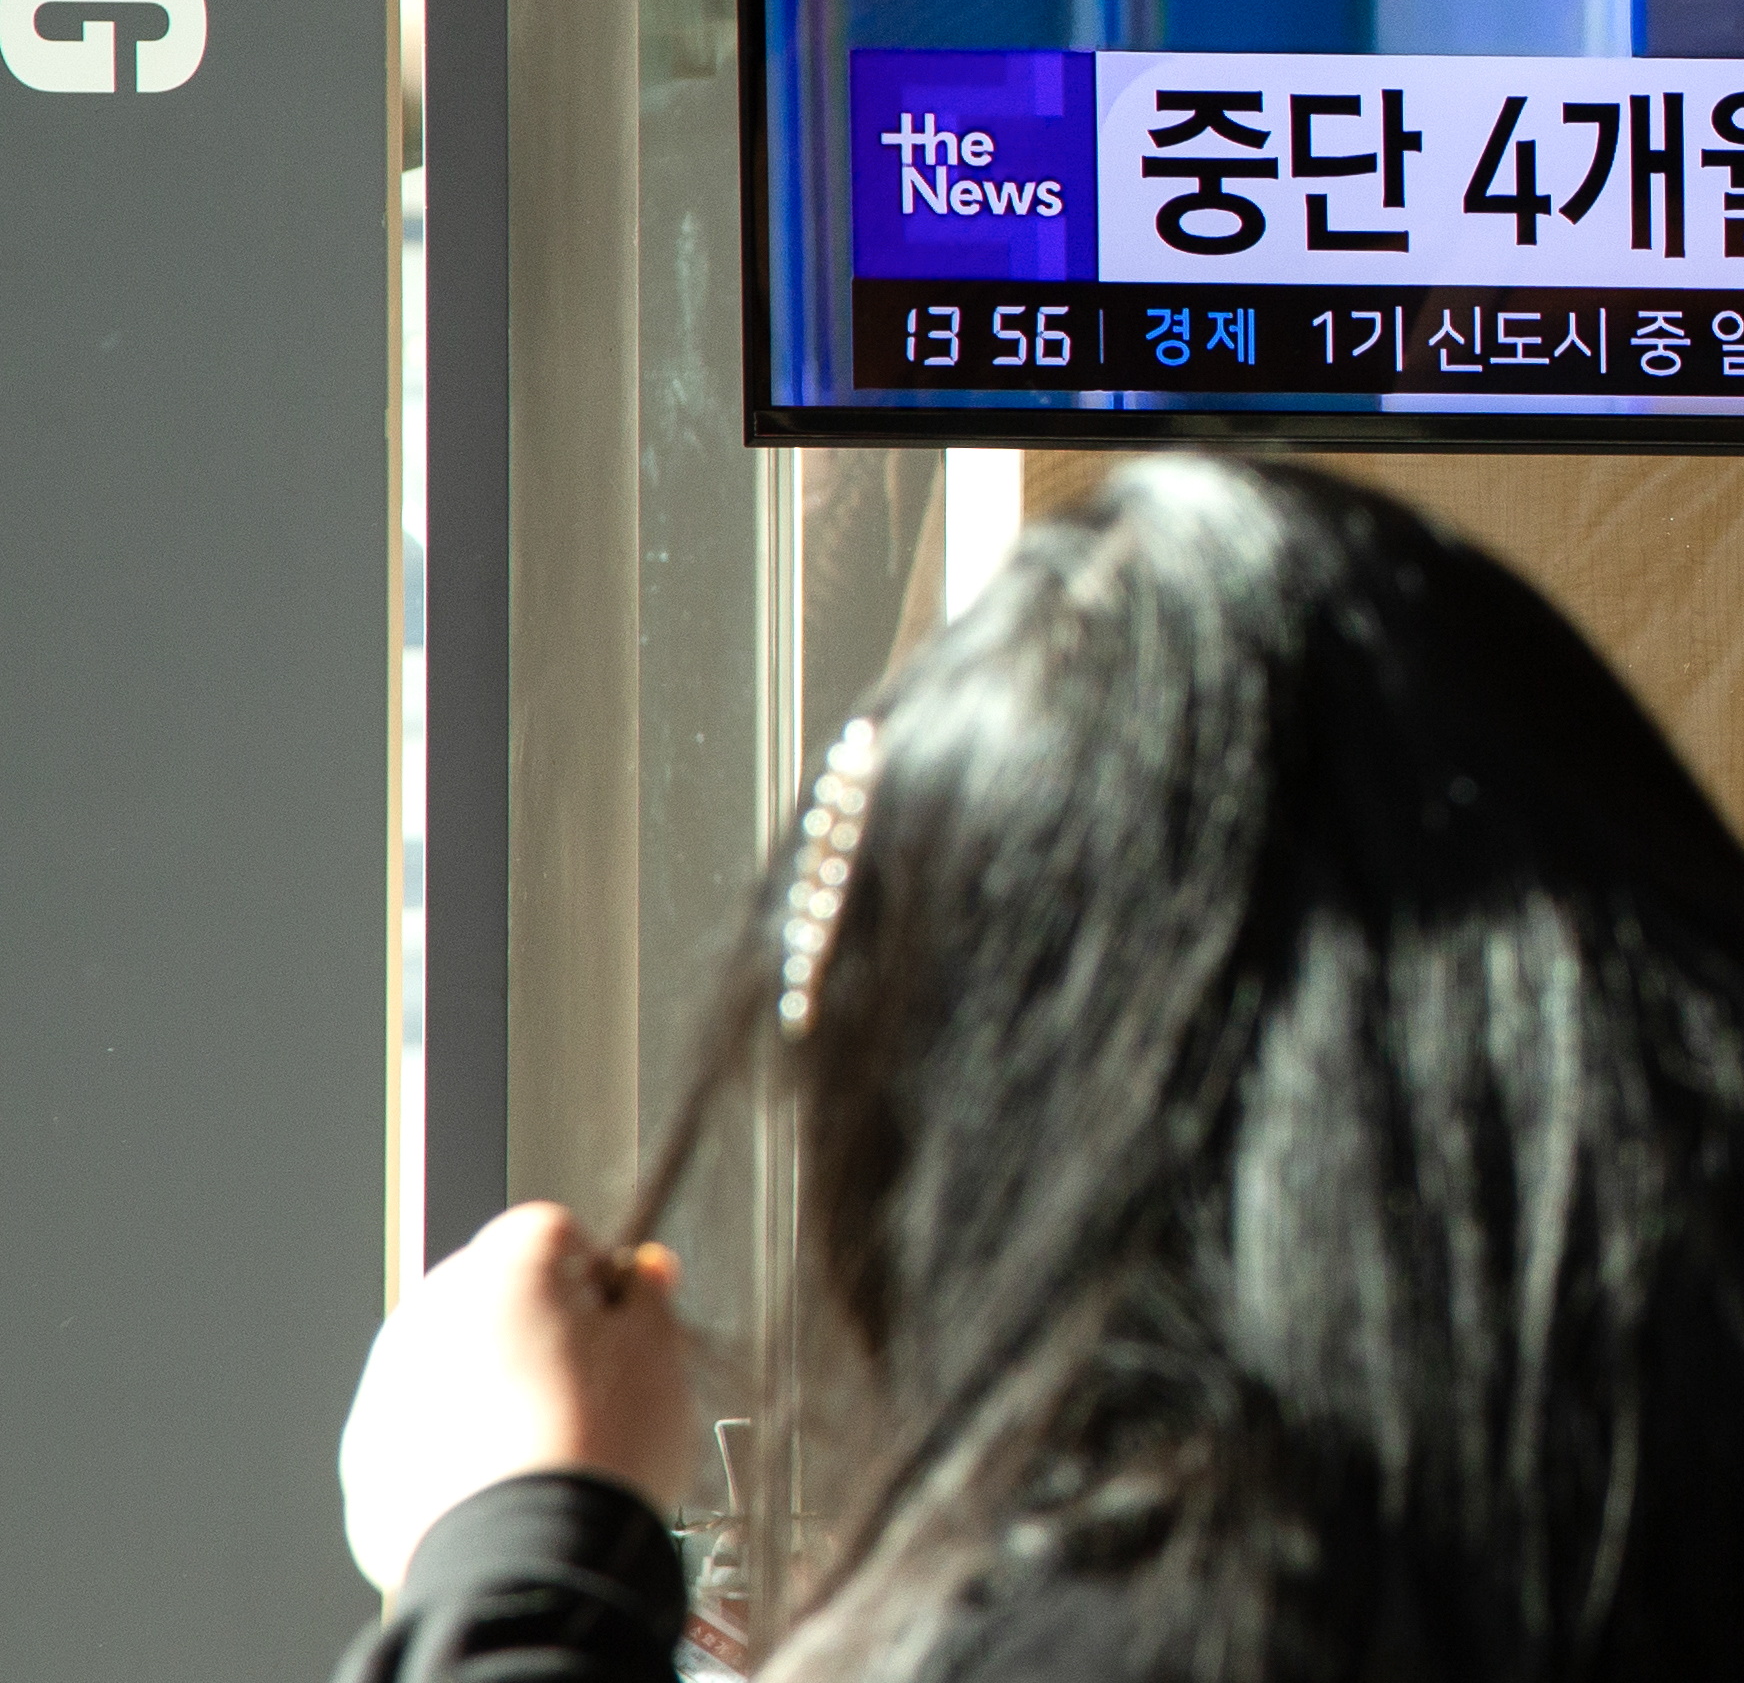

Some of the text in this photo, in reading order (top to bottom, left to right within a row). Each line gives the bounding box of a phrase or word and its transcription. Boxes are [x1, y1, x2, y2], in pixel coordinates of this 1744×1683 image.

[881, 112, 994, 167] the
[902, 165, 1063, 217] News
[1141, 88, 1423, 256] 중단
[906, 305, 1072, 367] 13 56
[1145, 307, 1256, 367] 경제
[1312, 305, 1404, 373] 1기
[1428, 307, 1607, 374] 신도시
[1630, 310, 1691, 377] 중
